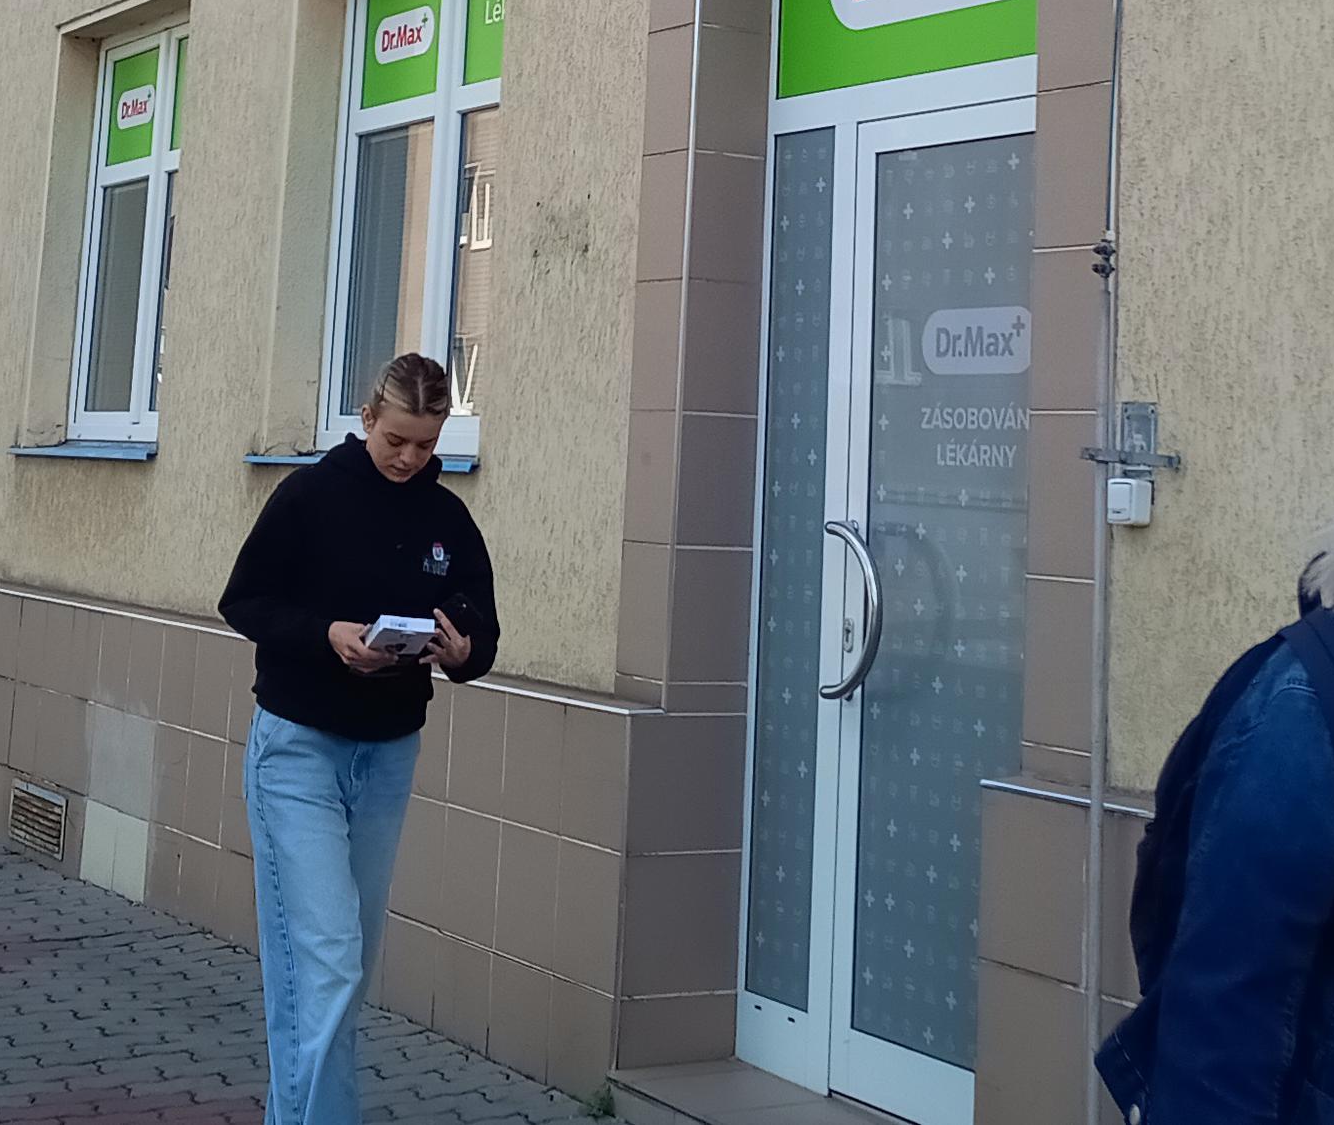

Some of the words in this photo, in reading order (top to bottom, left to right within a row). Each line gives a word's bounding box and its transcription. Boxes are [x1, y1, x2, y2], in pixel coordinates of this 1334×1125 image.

[381, 24, 423, 53] Dr.Max
[121, 98, 149, 121] Dr.Max
[935, 325, 1015, 359] Dr.Max
[936, 437, 1017, 468] LÉKÁRNY
